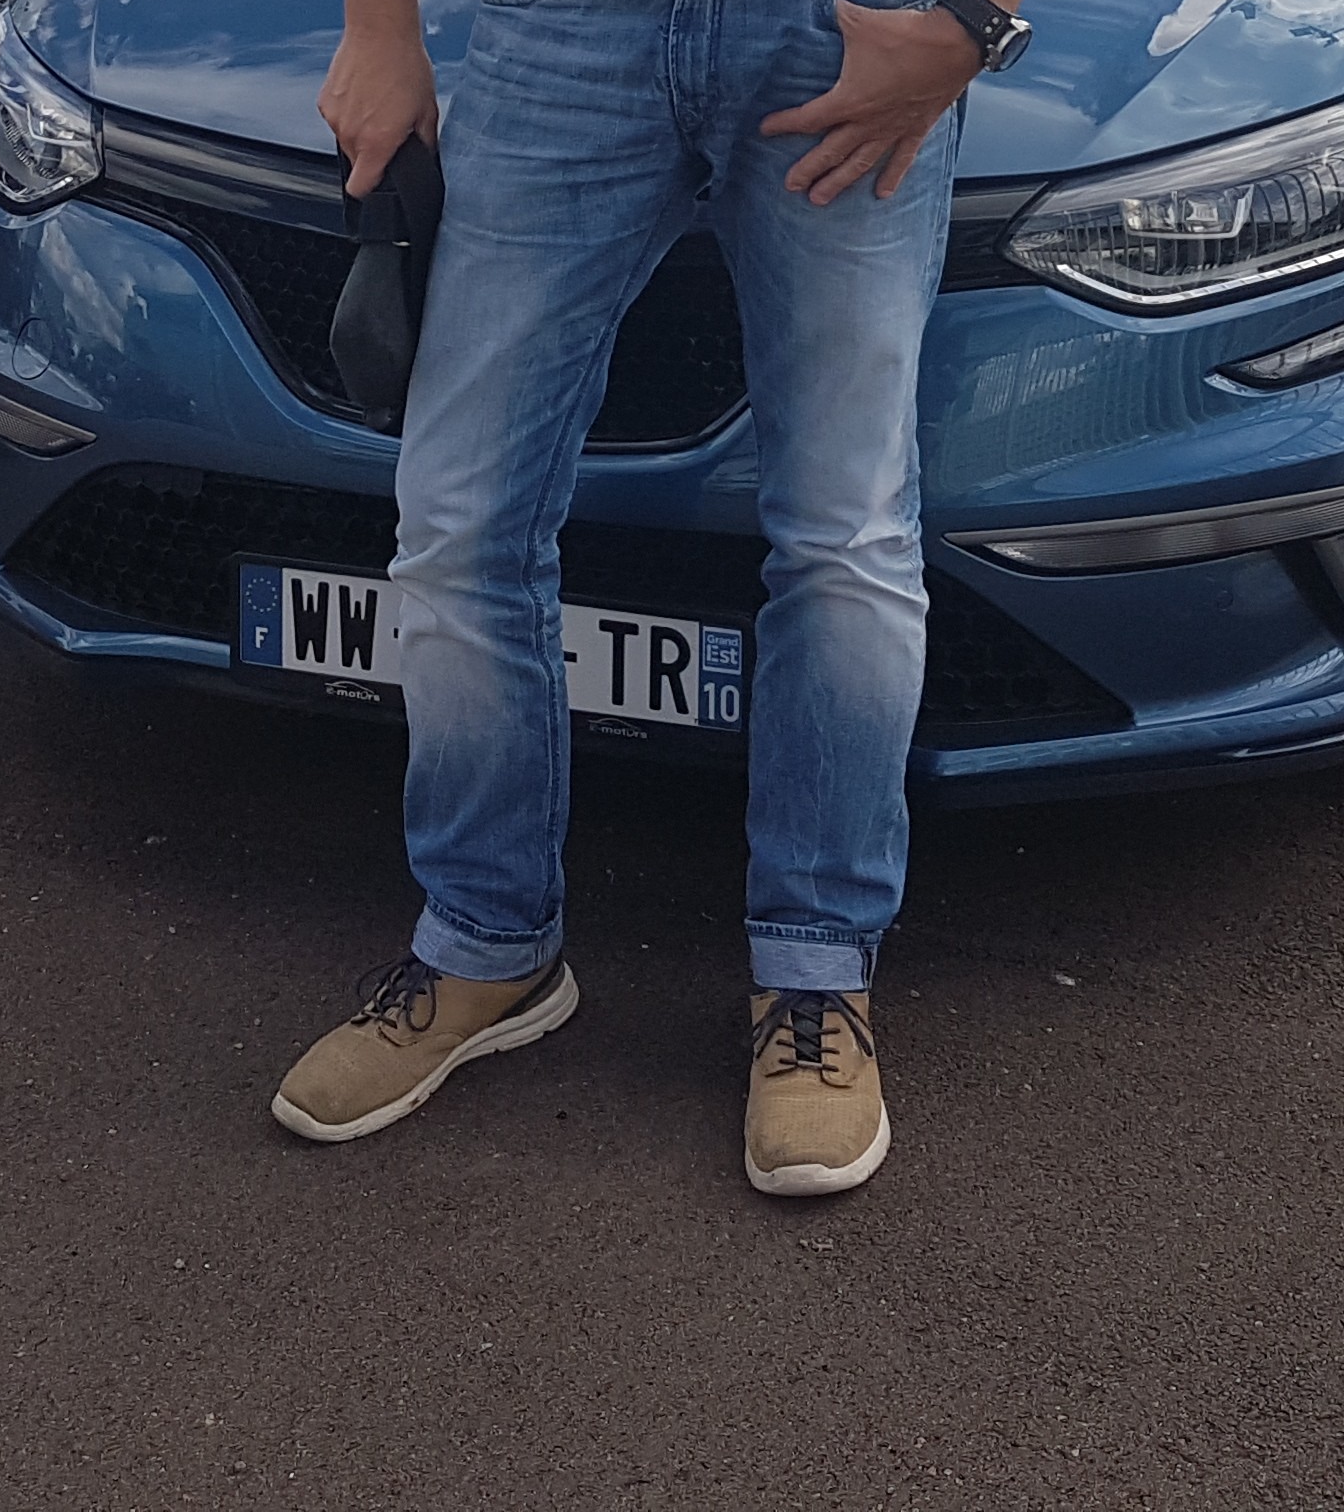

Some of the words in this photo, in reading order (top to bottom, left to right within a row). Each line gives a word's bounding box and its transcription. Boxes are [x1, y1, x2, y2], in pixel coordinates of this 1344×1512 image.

[255, 625, 269, 649] F
[707, 635, 739, 646] Grand
[706, 644, 738, 664] Est
[703, 682, 740, 722] 10
